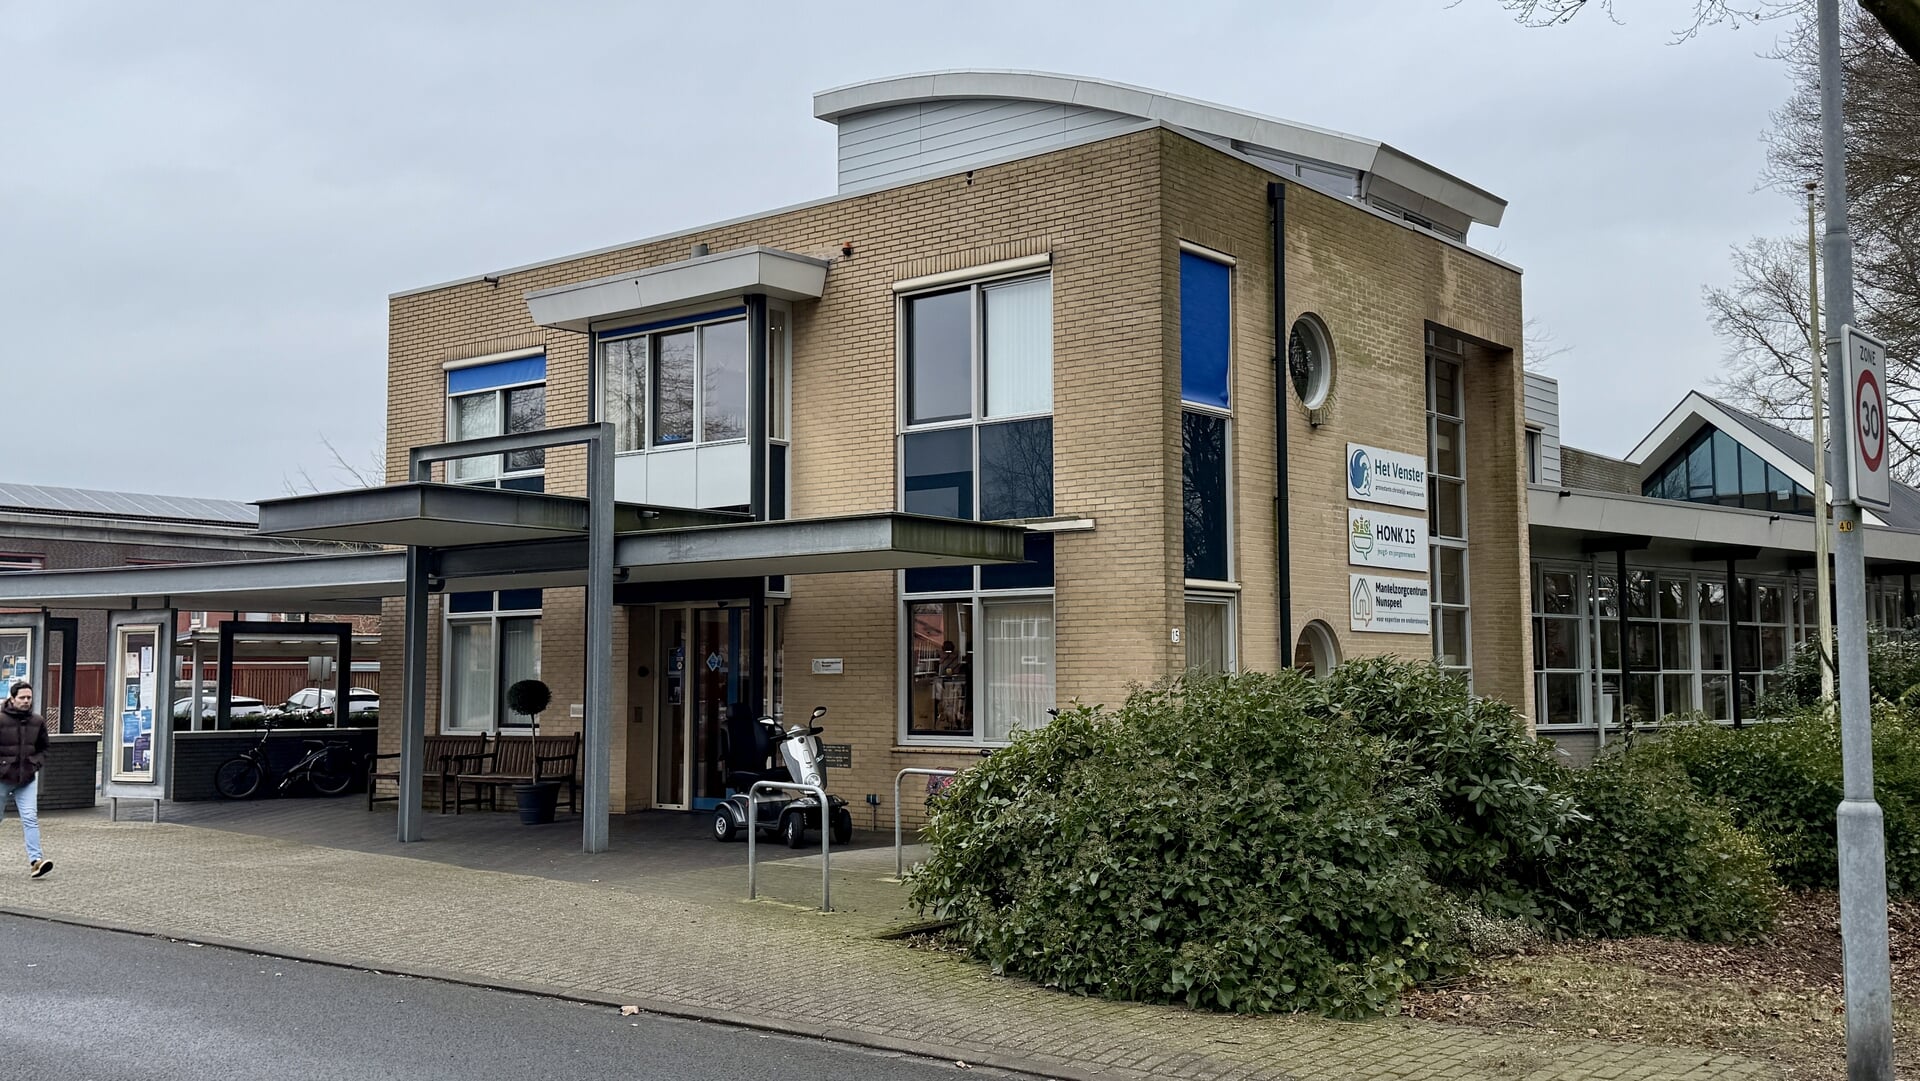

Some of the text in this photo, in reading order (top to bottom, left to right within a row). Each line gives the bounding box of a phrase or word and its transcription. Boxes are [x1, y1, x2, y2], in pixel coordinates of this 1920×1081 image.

[1859, 345, 1876, 366] ZONE
[1862, 400, 1879, 441] 30
[1374, 459, 1424, 483] Het Venster
[1376, 524, 1404, 543] HONK
[1405, 528, 1416, 544] 15
[1839, 521, 1852, 531] 40
[1375, 582, 1428, 597] Mantelzorgcentrum
[1375, 596, 1403, 610] Nunspeet
[1173, 630, 1179, 641] 15
